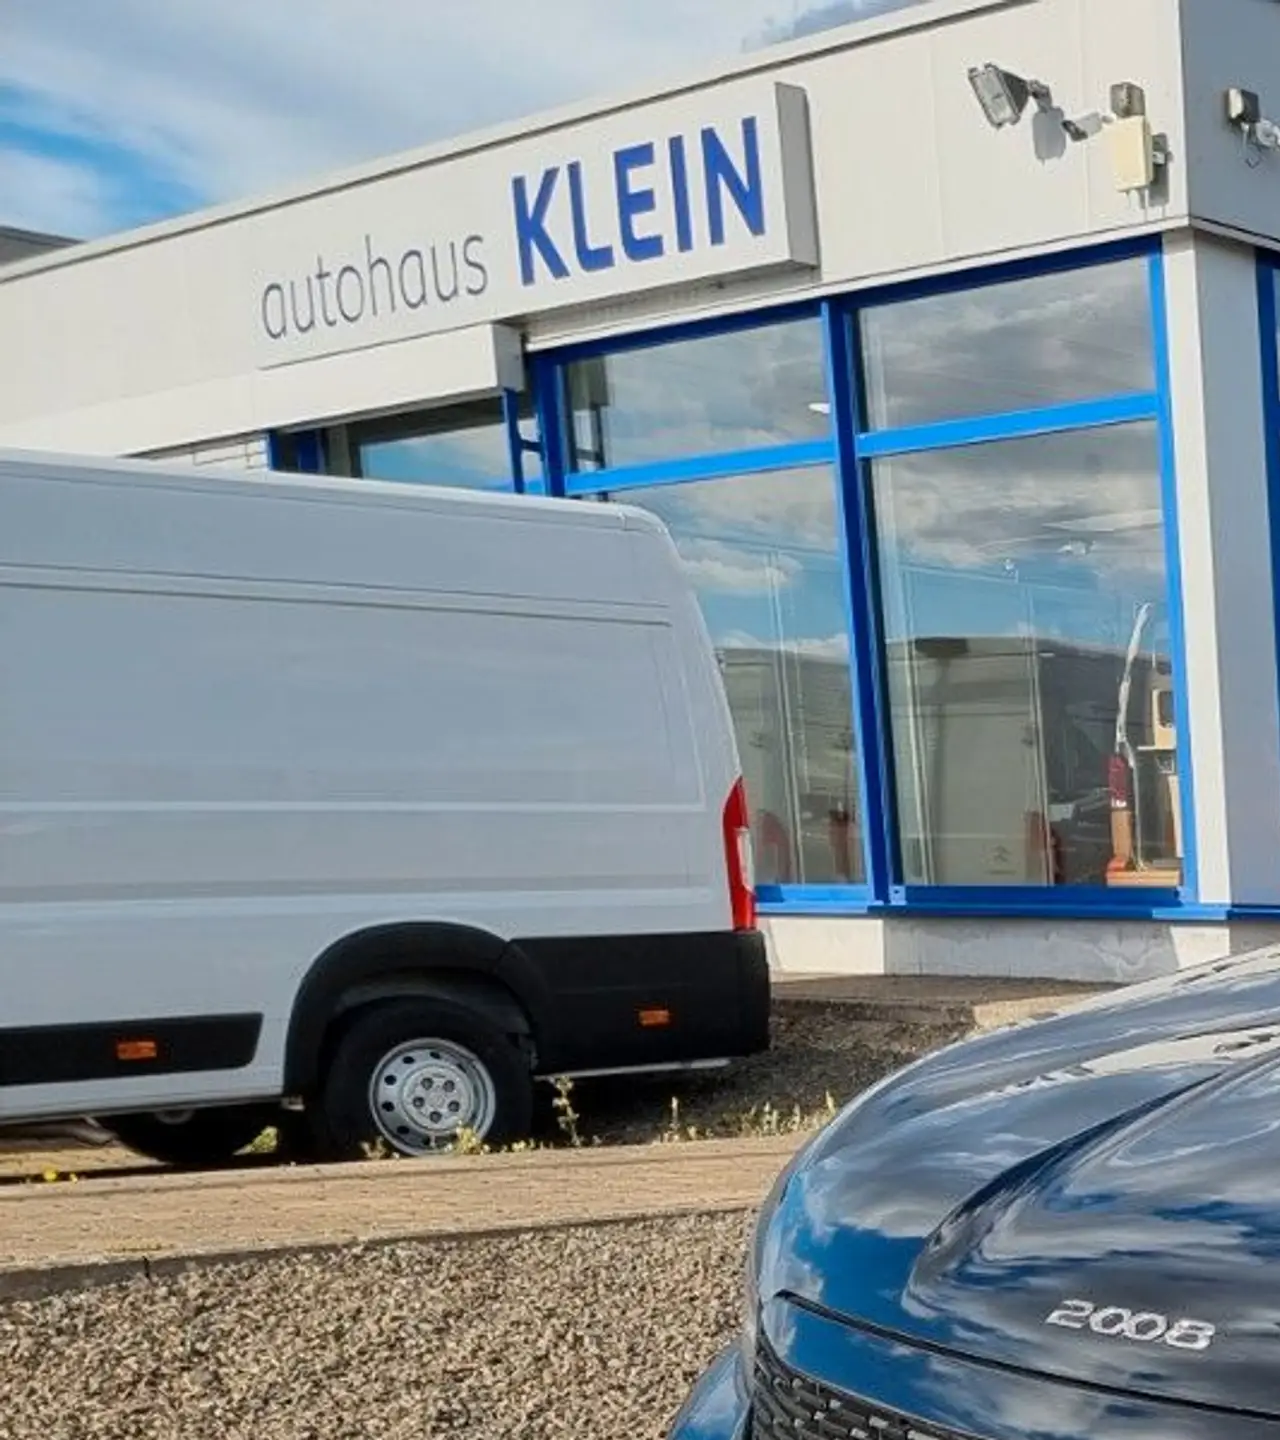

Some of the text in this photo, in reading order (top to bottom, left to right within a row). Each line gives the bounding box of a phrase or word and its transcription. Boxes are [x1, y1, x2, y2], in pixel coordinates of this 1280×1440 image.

[261, 116, 767, 342] autohaus KLEIN
[1045, 1299, 1217, 1350] 2008
